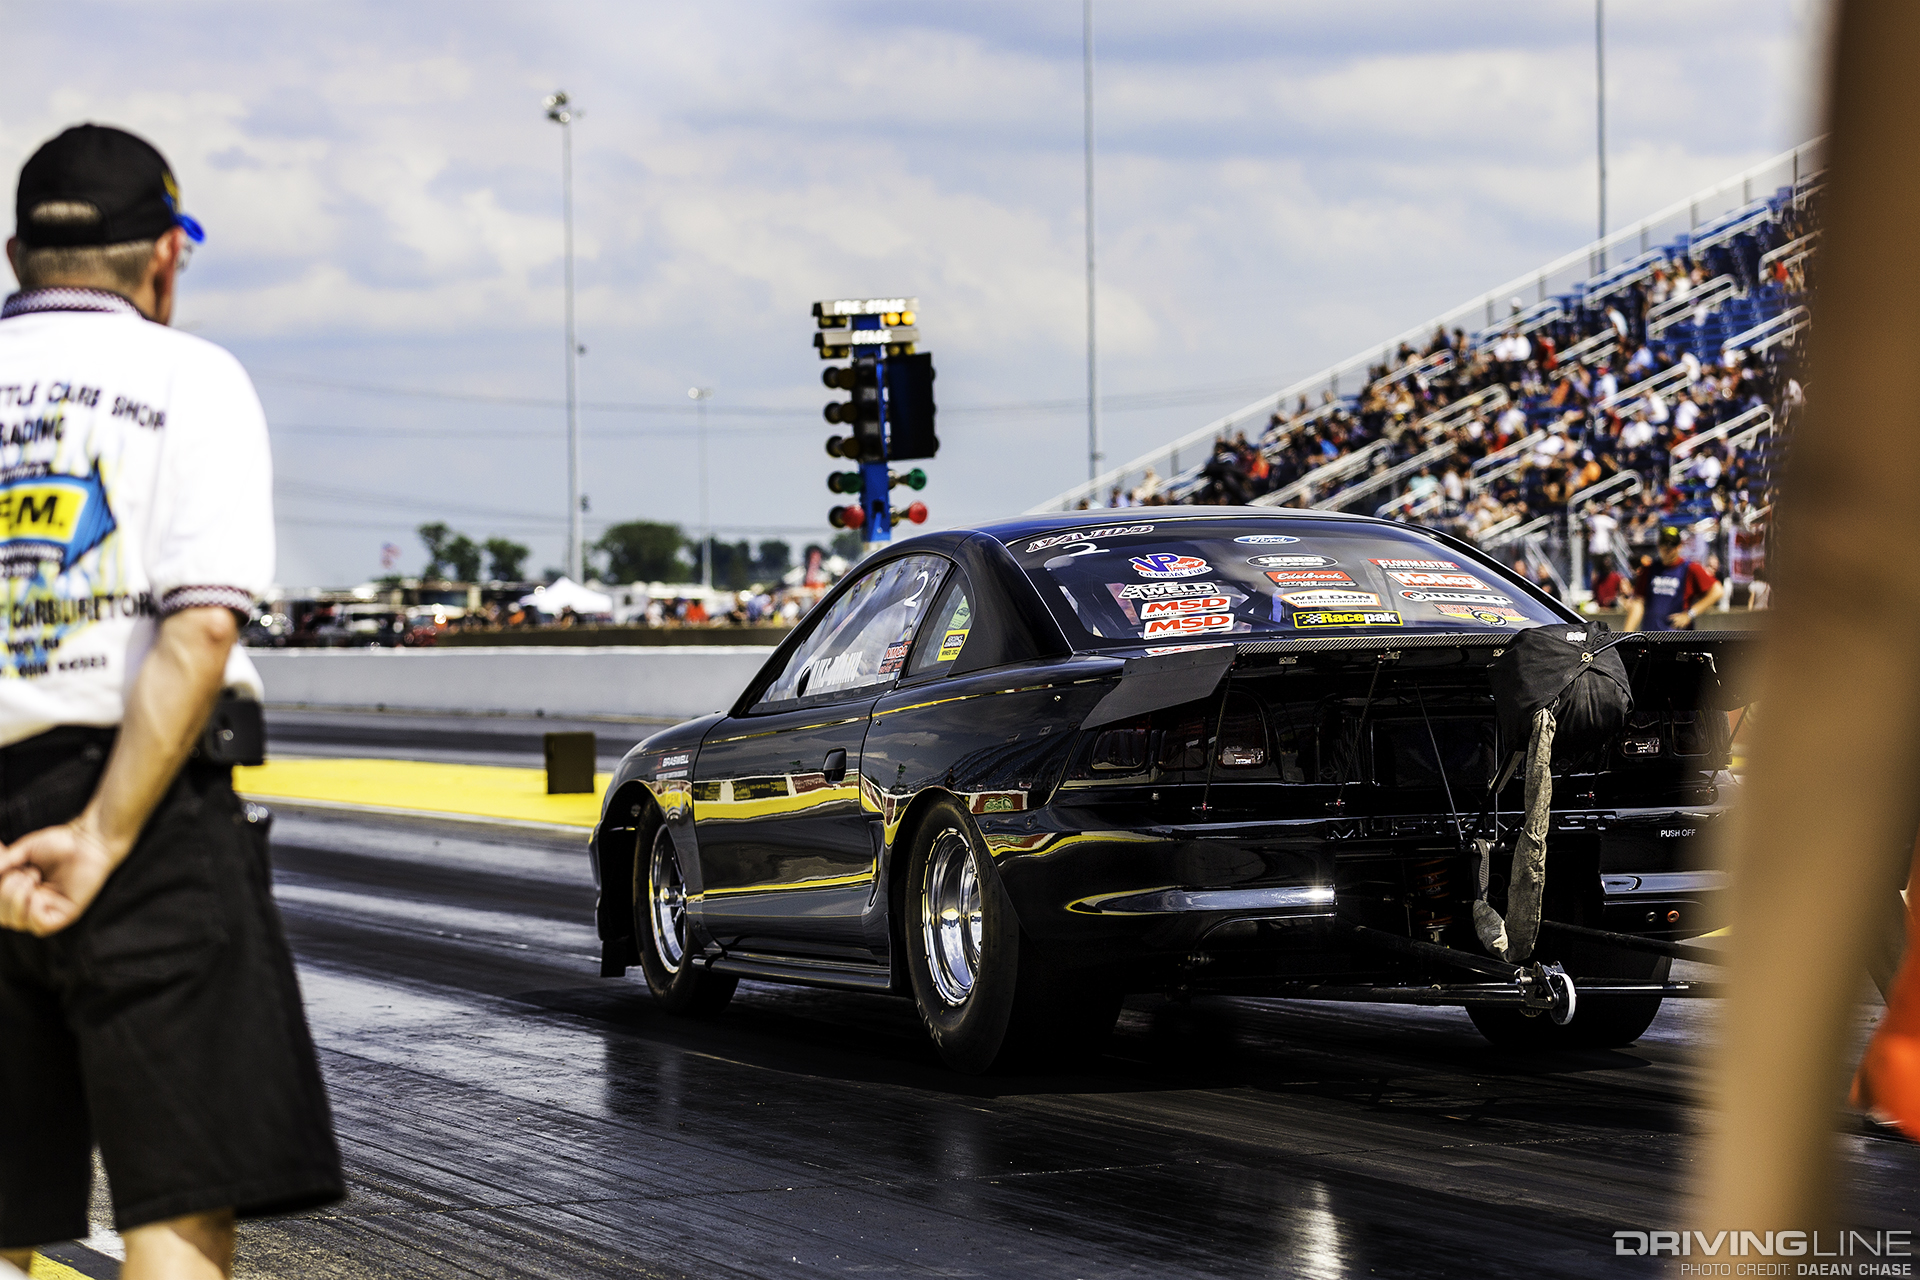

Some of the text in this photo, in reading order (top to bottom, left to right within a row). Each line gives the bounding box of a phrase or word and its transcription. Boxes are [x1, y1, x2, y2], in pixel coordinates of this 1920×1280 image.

[1131, 554, 1179, 573] VP
[1376, 559, 1456, 569] FLOWMASTER
[1396, 571, 1487, 589] Holley
[903, 570, 929, 608] 2
[1142, 583, 1216, 595] WELD
[1147, 598, 1228, 613] MSD
[1148, 616, 1230, 633] MSD
[1320, 612, 1398, 625] Racepak
[883, 645, 908, 660] NMCA
[1660, 828, 1696, 837] PUSH OFF
